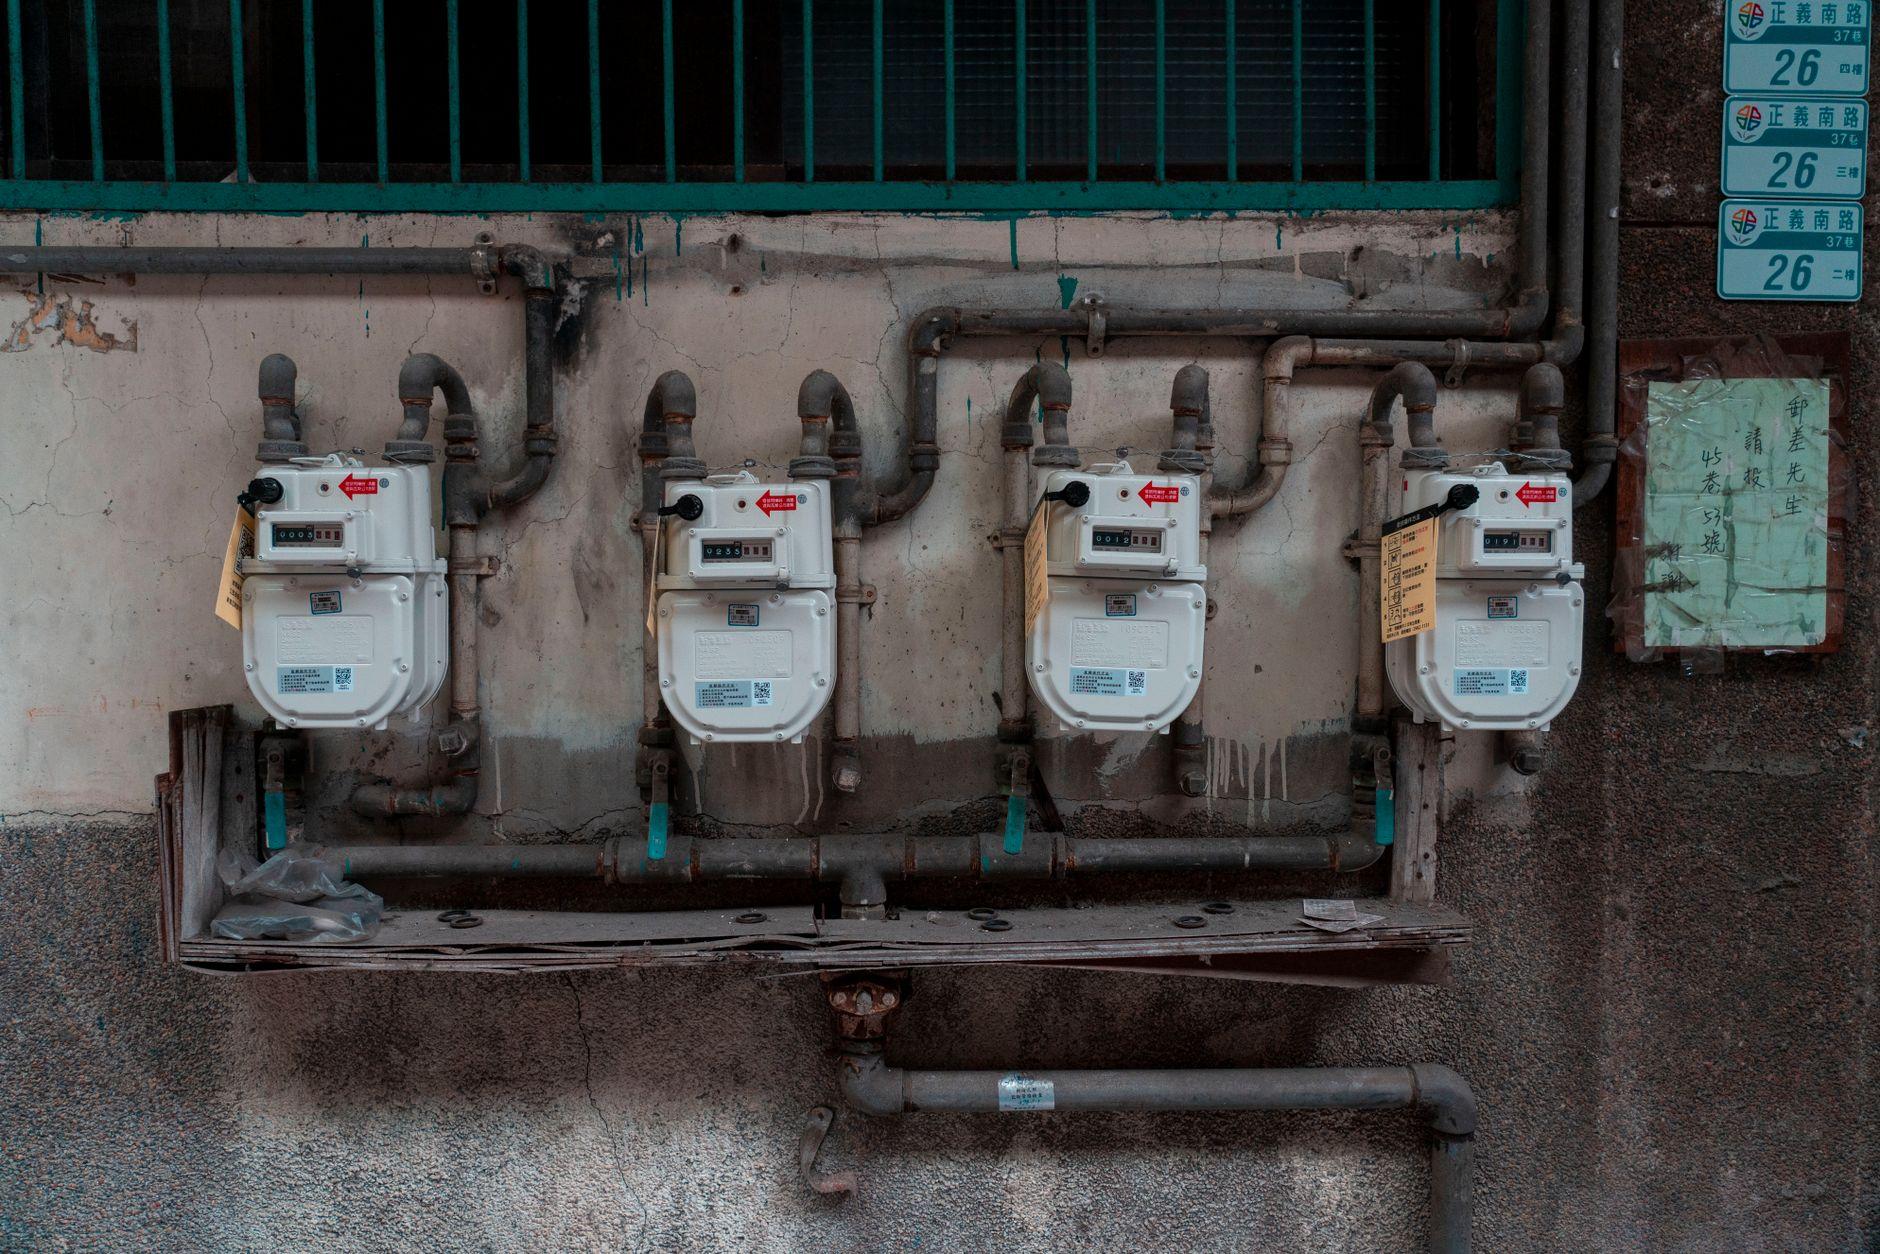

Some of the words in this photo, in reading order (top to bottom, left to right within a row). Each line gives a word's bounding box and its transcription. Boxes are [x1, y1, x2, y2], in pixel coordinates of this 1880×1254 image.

[1770, 1, 1862, 25] 正義南路
[1833, 30, 1862, 43] 37巷
[1769, 48, 1822, 87] 26
[1839, 63, 1863, 75] 四樓
[1767, 103, 1860, 129] 正義南路
[1767, 151, 1819, 189] 26
[1836, 166, 1860, 179] 三樓
[1763, 207, 1855, 232] 正義南路
[1826, 236, 1855, 248] 37巷
[1763, 254, 1815, 292] 26
[1832, 268, 1856, 282] 二樓
[1743, 427, 1766, 489] 請投
[1785, 394, 1809, 516] 郵差先生
